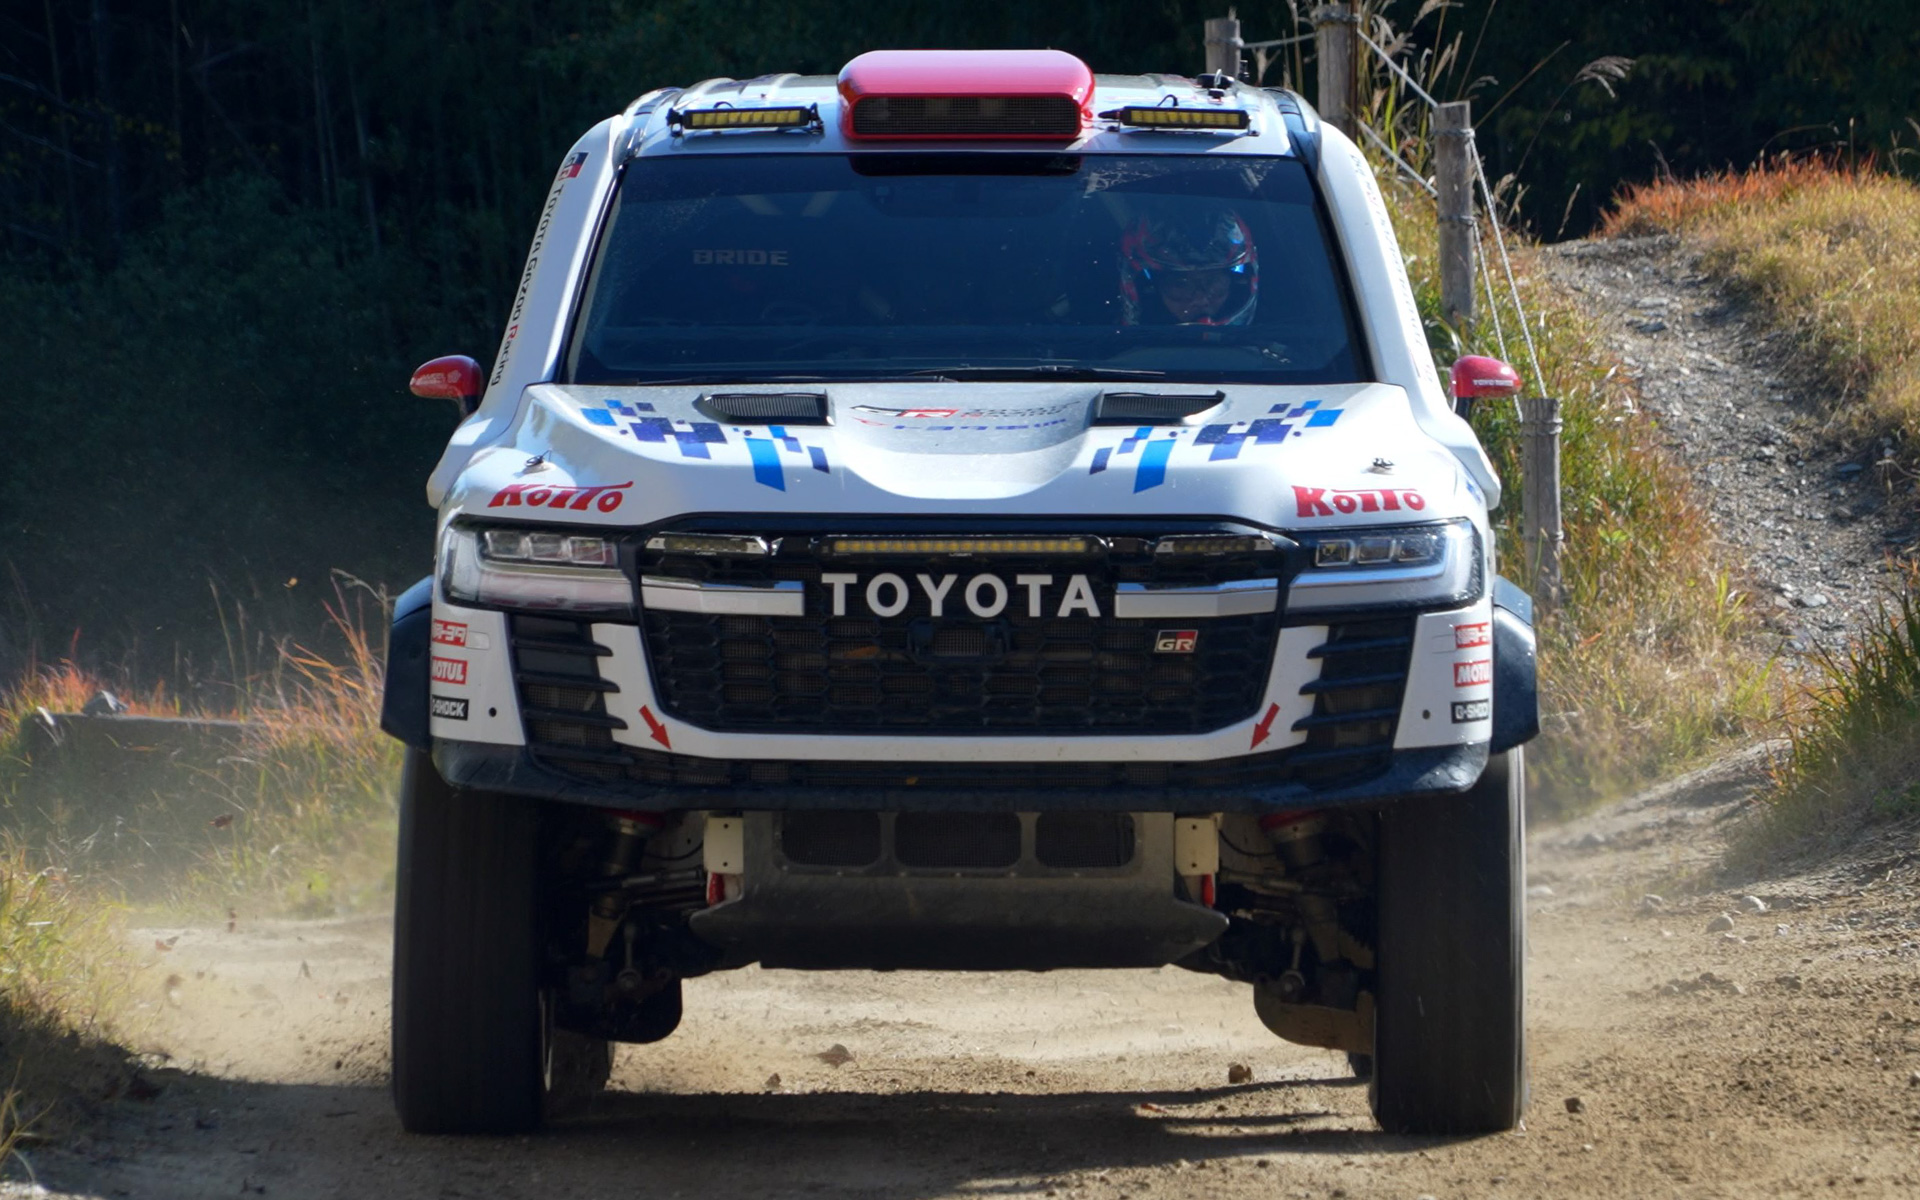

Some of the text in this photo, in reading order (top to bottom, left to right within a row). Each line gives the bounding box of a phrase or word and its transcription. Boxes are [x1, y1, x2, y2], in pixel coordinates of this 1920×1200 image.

[532, 184, 564, 253] TOYOTA
[692, 249, 789, 266] BRIDE
[512, 257, 538, 321] GAZOO
[490, 324, 519, 386] Racing
[821, 573, 1101, 618] TOYOTA
[1157, 637, 1195, 651] GR
